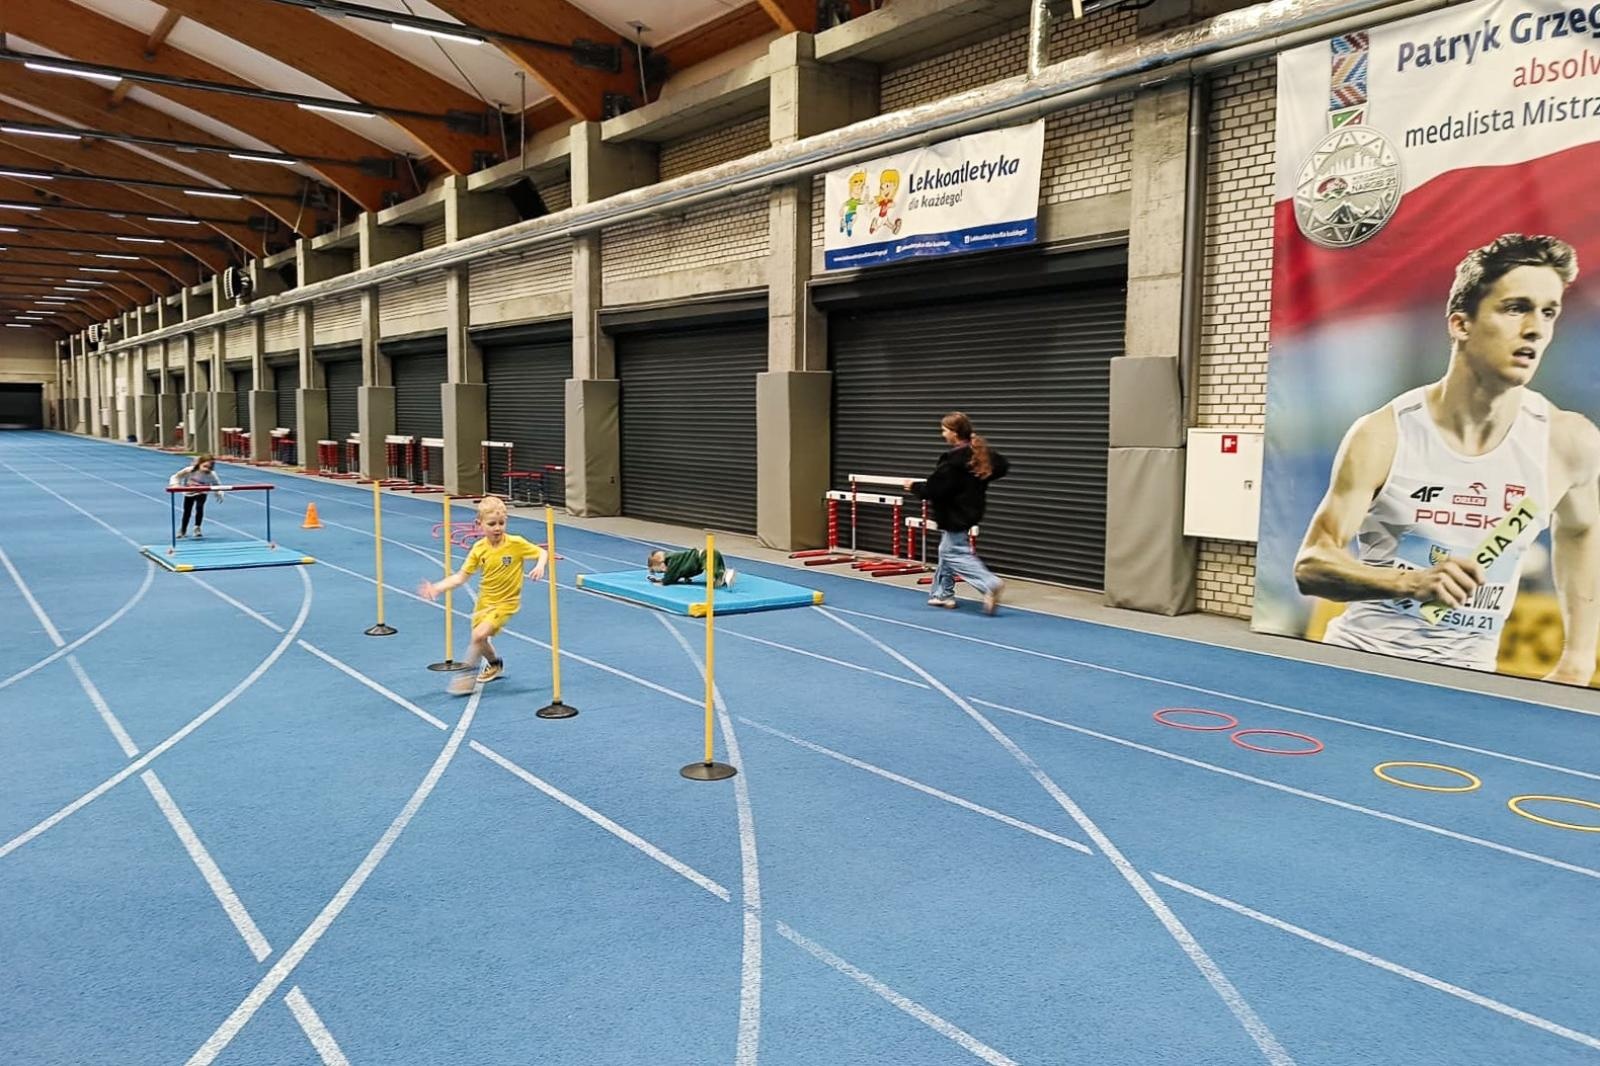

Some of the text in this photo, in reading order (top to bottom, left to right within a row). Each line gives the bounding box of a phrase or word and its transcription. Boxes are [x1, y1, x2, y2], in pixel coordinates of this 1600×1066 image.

[1397, 4, 1600, 72] Patryk Grzeg
[1405, 96, 1600, 149] medalista Mistrz
[908, 154, 1020, 194] Lekkoatletyka
[921, 189, 963, 208] każdego!
[1410, 485, 1444, 503] 4F
[1509, 508, 1534, 534] 21
[1465, 586, 1505, 610] WICZ
[1478, 616, 1494, 630] 21
